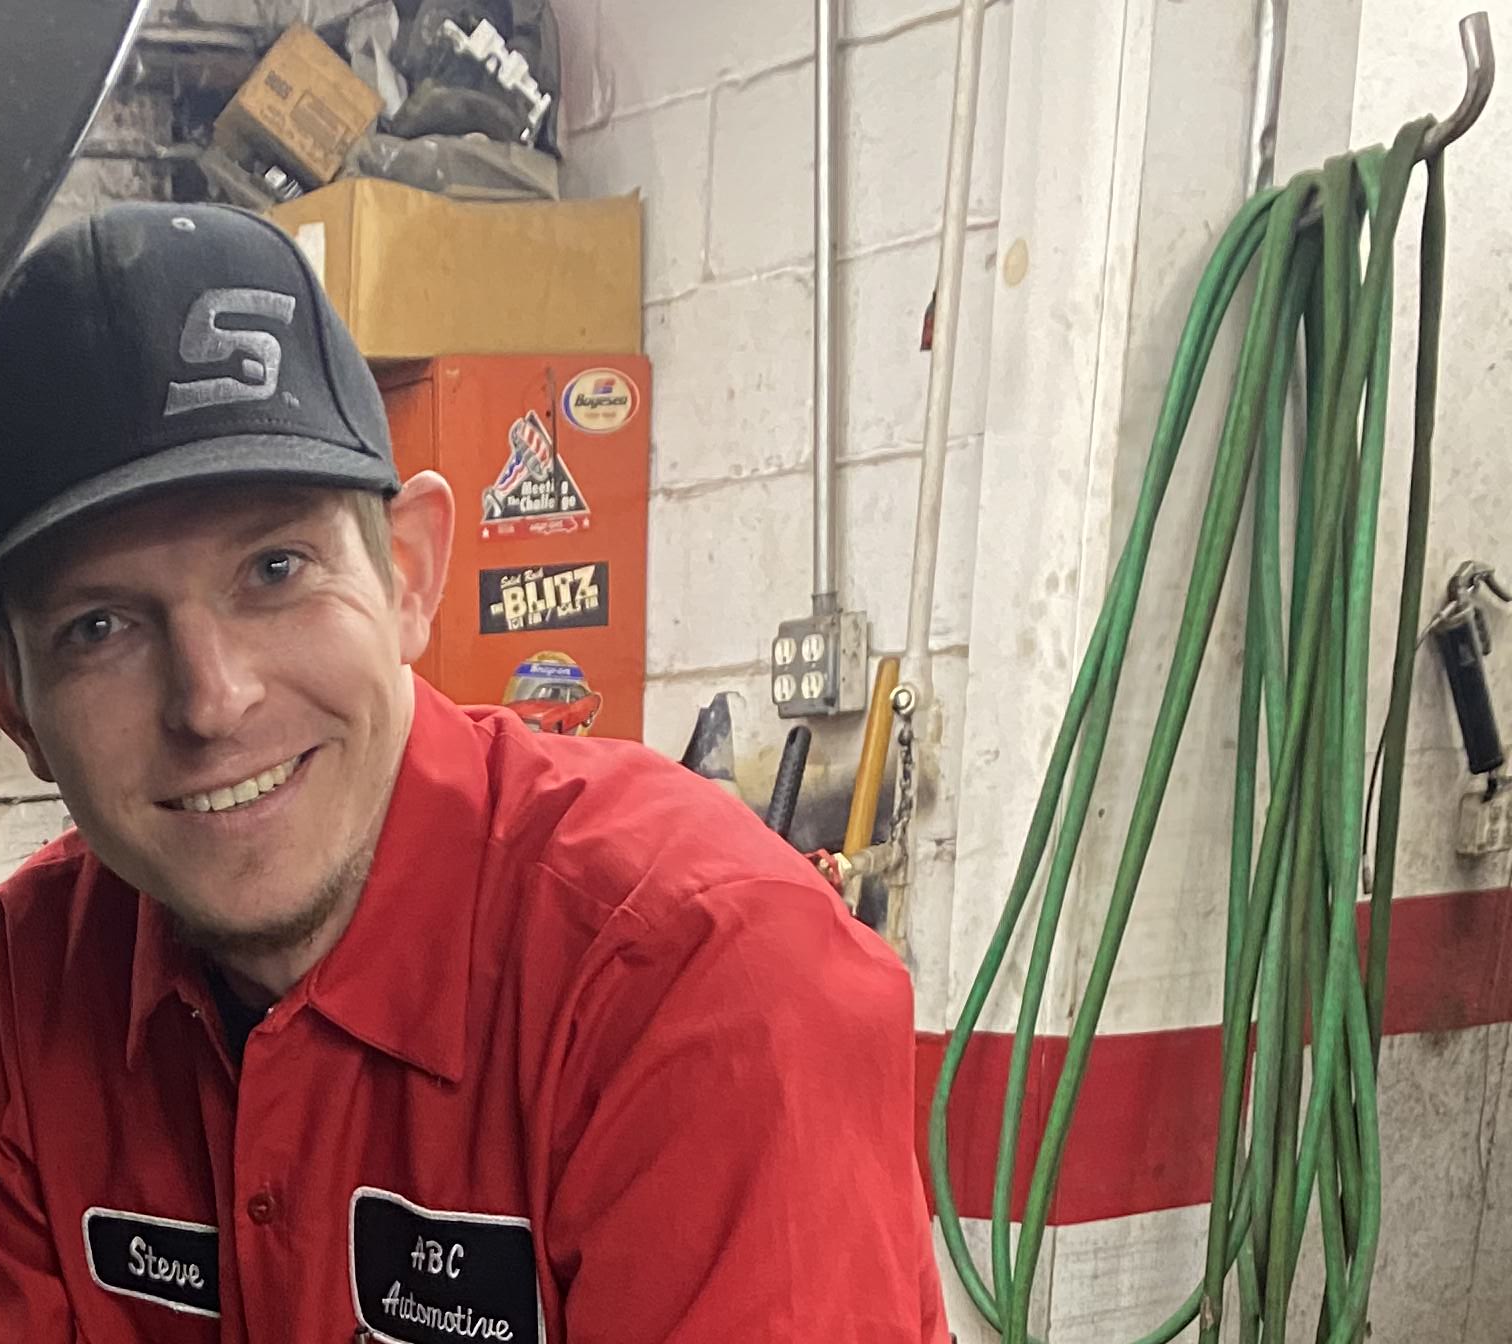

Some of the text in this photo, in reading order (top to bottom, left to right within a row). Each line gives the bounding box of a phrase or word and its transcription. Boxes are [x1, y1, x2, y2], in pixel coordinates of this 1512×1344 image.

[520, 493, 576, 512] Challege
[521, 478, 568, 496] Meetig
[503, 565, 598, 620] BLITZ
[127, 1236, 205, 1290] Steve
[410, 1236, 466, 1280] ABC
[382, 1281, 514, 1342] Automotive
